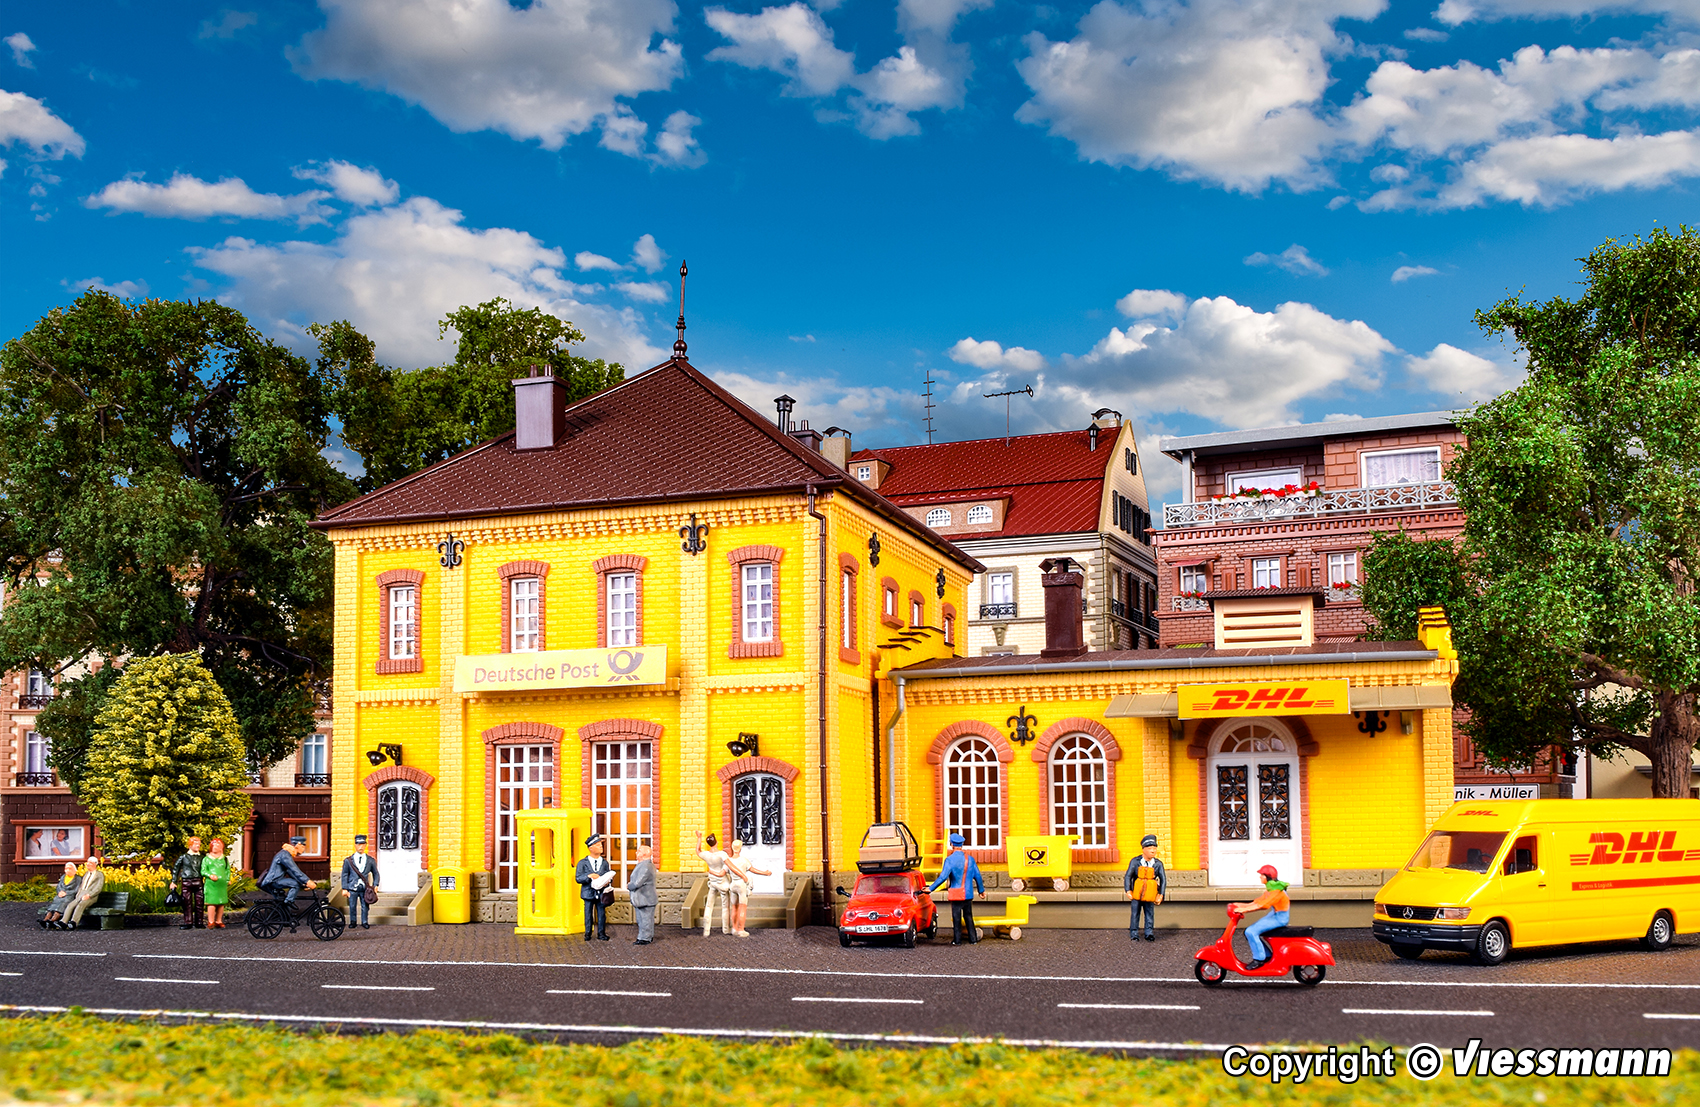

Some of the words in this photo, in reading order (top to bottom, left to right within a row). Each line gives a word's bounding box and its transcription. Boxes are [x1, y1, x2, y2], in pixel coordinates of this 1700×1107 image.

[474, 663, 555, 684] Deutsche
[560, 662, 600, 680] Post
[1211, 687, 1315, 711] DHL
[1489, 787, 1534, 799] Müller
[1588, 831, 1686, 866] DHL
